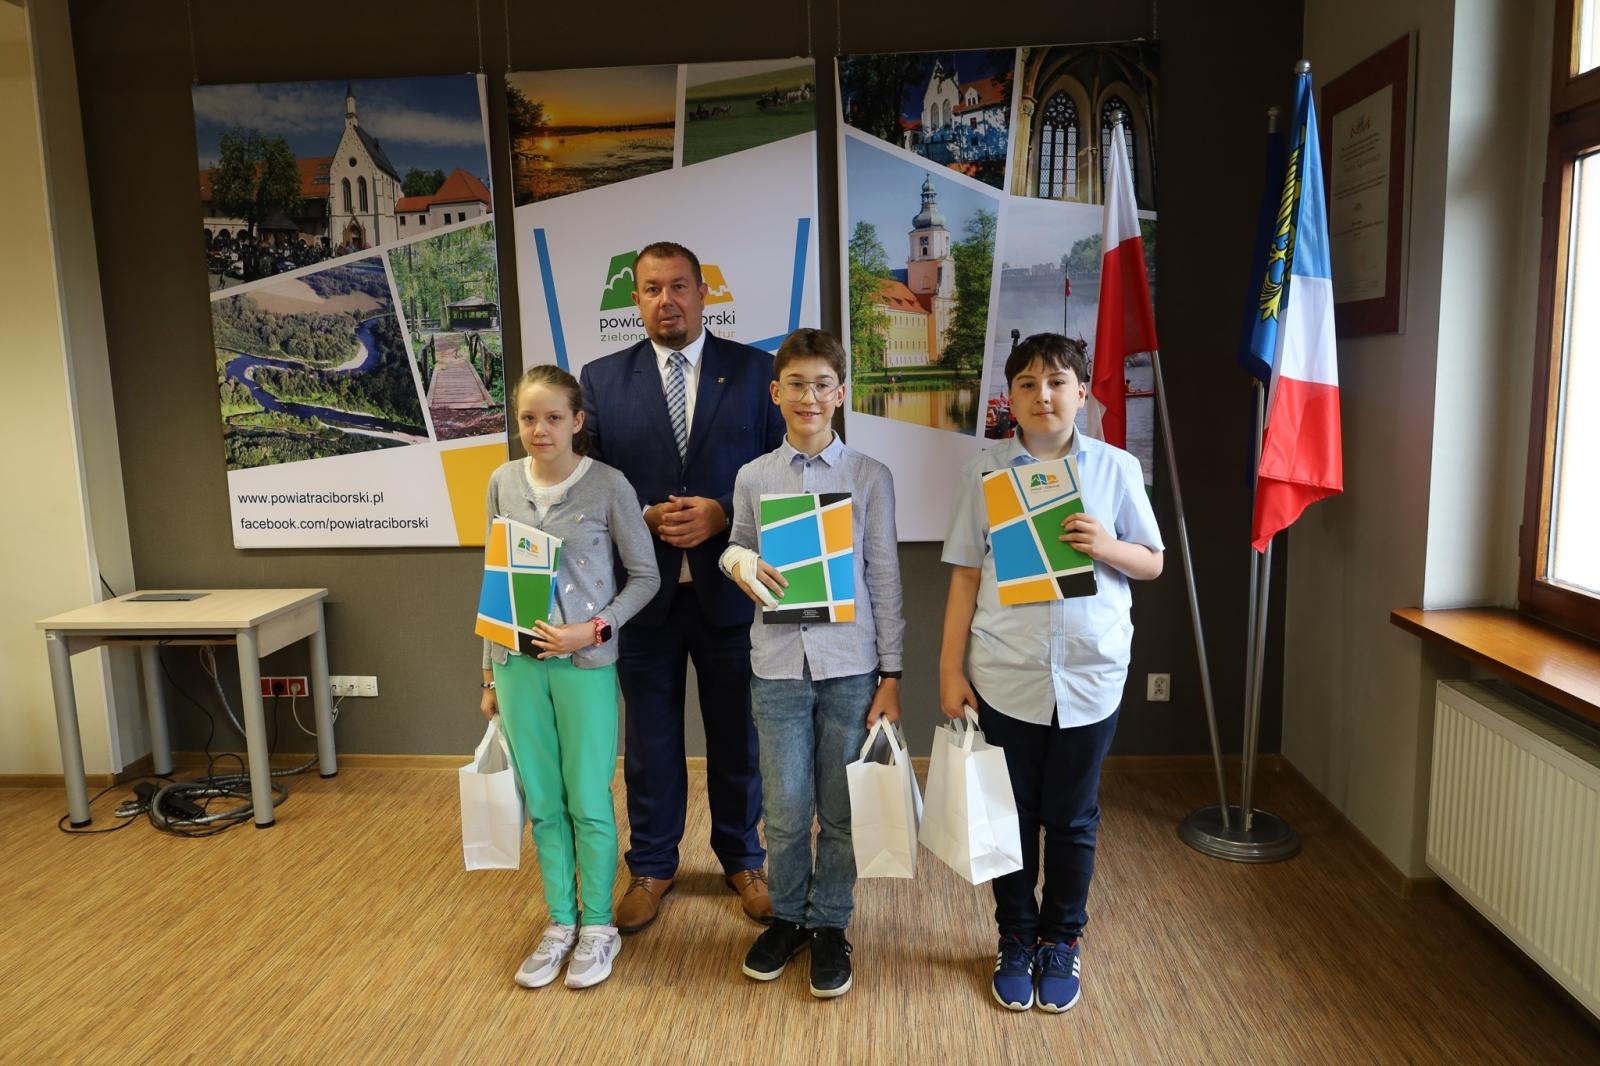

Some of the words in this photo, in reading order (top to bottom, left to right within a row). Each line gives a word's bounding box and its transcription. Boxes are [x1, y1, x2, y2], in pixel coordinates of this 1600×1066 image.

[599, 313, 645, 332] powia
[700, 310, 736, 325] orski
[713, 329, 737, 338] ltur
[237, 491, 384, 506] www.powiatraciborski.pl
[240, 516, 429, 531] facebook.com/powiatraciborski
